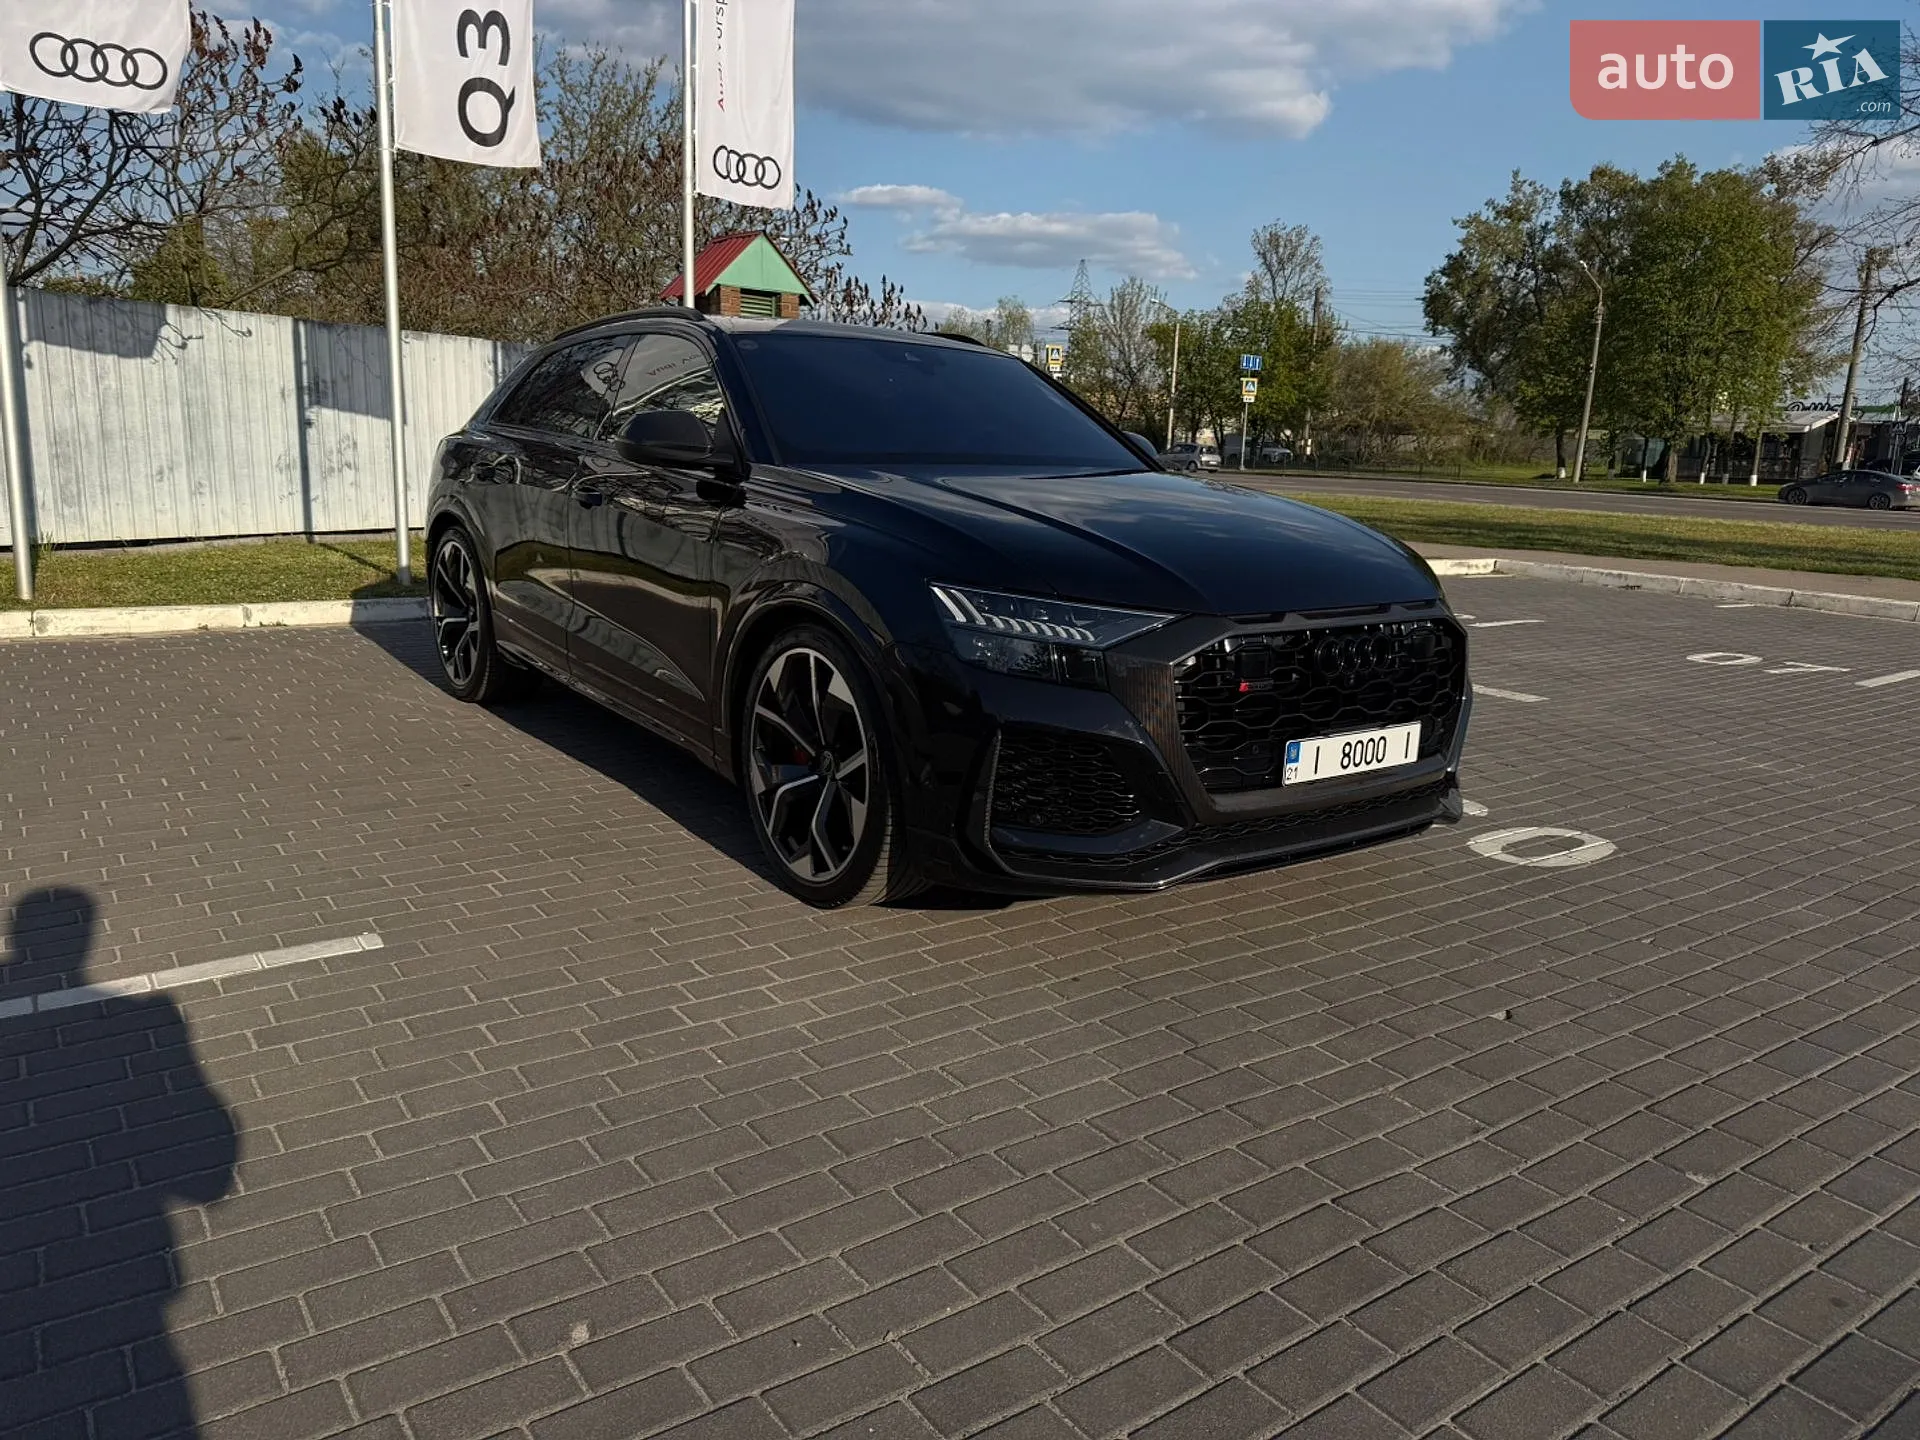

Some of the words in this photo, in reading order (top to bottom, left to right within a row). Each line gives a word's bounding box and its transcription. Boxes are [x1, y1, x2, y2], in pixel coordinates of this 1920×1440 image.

[457, 9, 516, 147] Q3
[1340, 735, 1387, 769] 8000
[1286, 766, 1299, 780] 21
